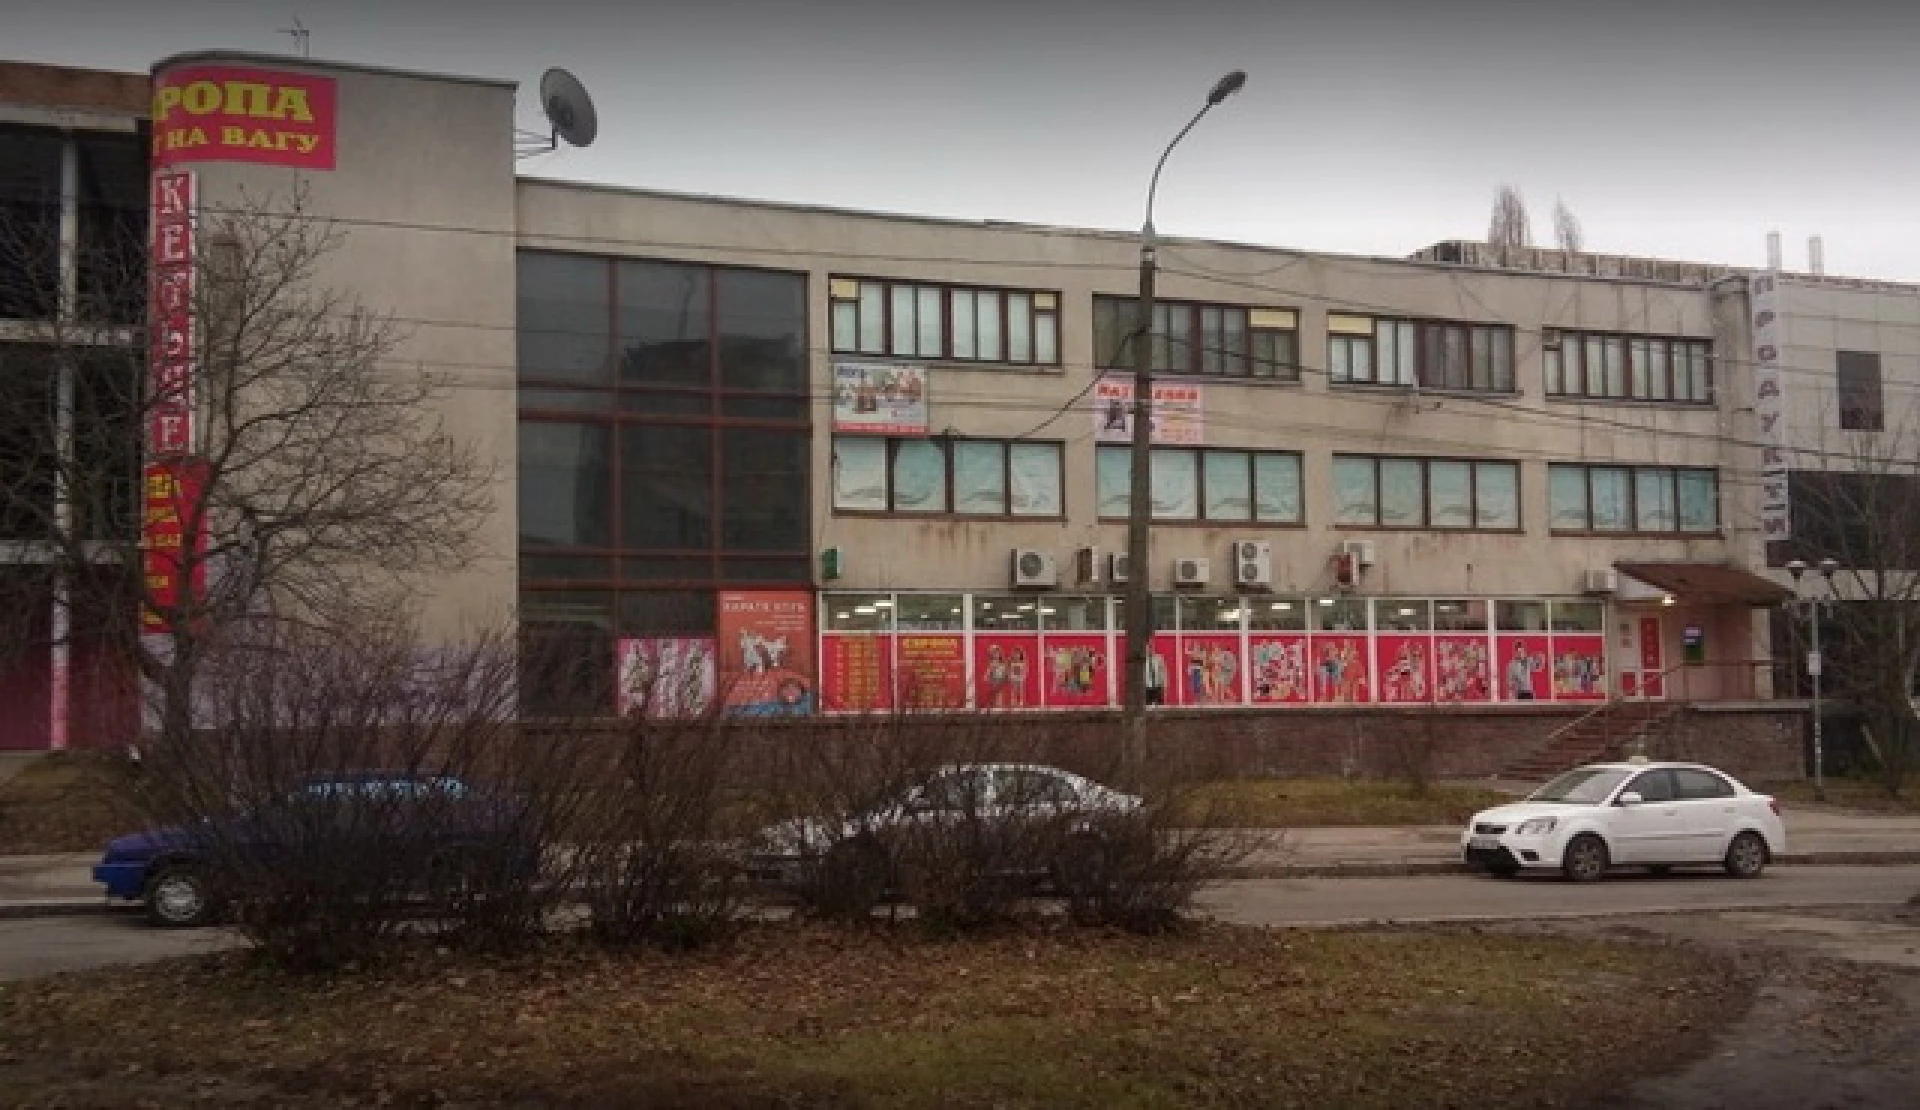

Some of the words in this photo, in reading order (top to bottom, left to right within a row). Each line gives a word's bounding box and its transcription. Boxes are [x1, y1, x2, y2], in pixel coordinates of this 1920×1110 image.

[153, 81, 314, 122] РОПА
[167, 127, 210, 148] НА
[221, 126, 319, 153] ВАГУ
